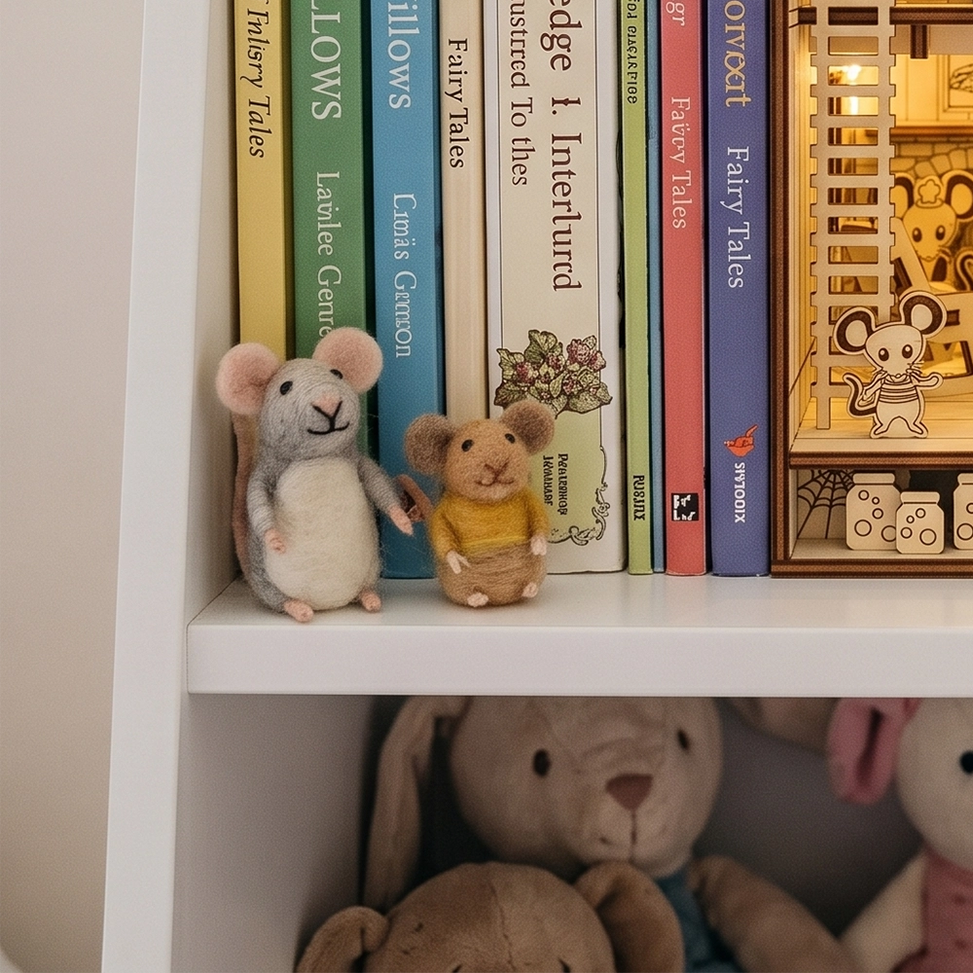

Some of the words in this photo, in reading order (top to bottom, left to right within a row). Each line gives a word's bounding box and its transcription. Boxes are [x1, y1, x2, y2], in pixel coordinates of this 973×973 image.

[444, 38, 468, 103] Fairy
[248, 95, 272, 159] Tales
[448, 107, 470, 169] Tales
[510, 96, 534, 128] To
[511, 136, 536, 186] thes
[719, 145, 750, 215] Fairy
[670, 169, 693, 229] Tales
[726, 221, 752, 289] Tales
